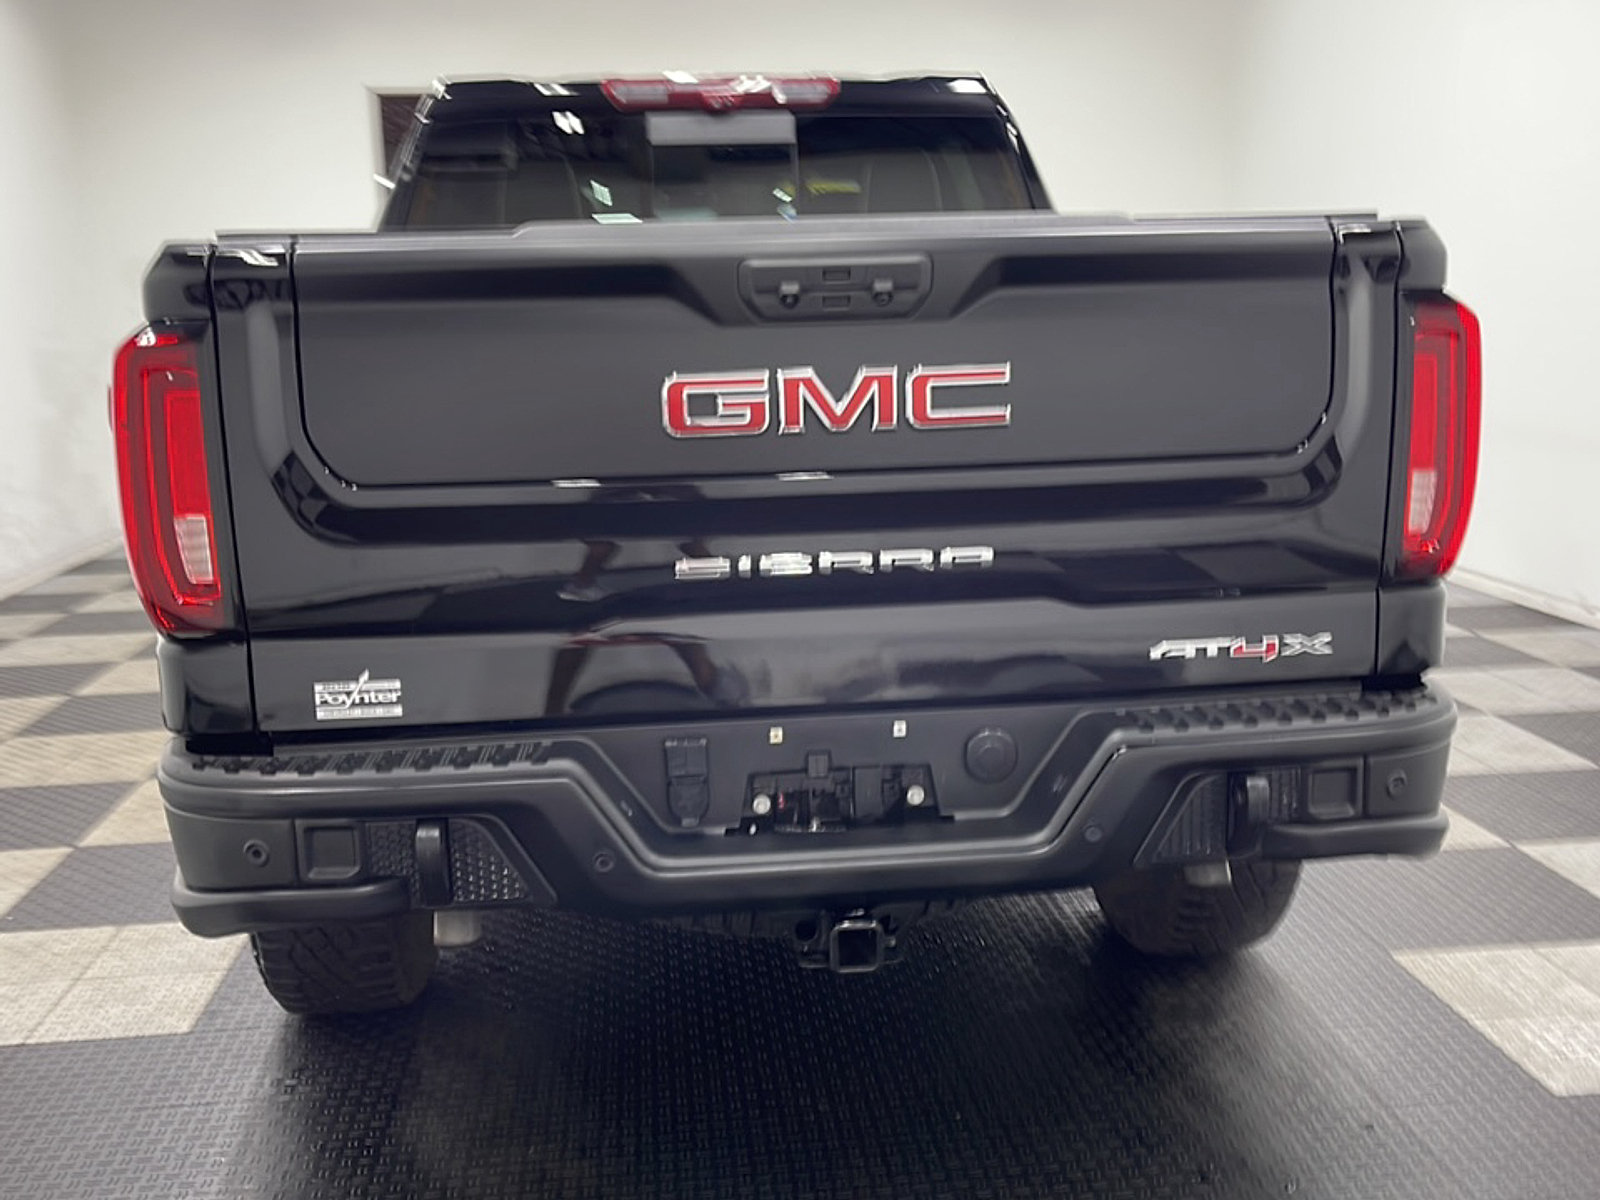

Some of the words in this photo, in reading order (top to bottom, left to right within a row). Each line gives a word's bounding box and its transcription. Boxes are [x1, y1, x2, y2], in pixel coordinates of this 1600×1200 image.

[661, 360, 1012, 439] GMC
[674, 546, 994, 580] SIERRA
[1149, 631, 1333, 663] AT4X
[315, 684, 402, 708] Poynter
